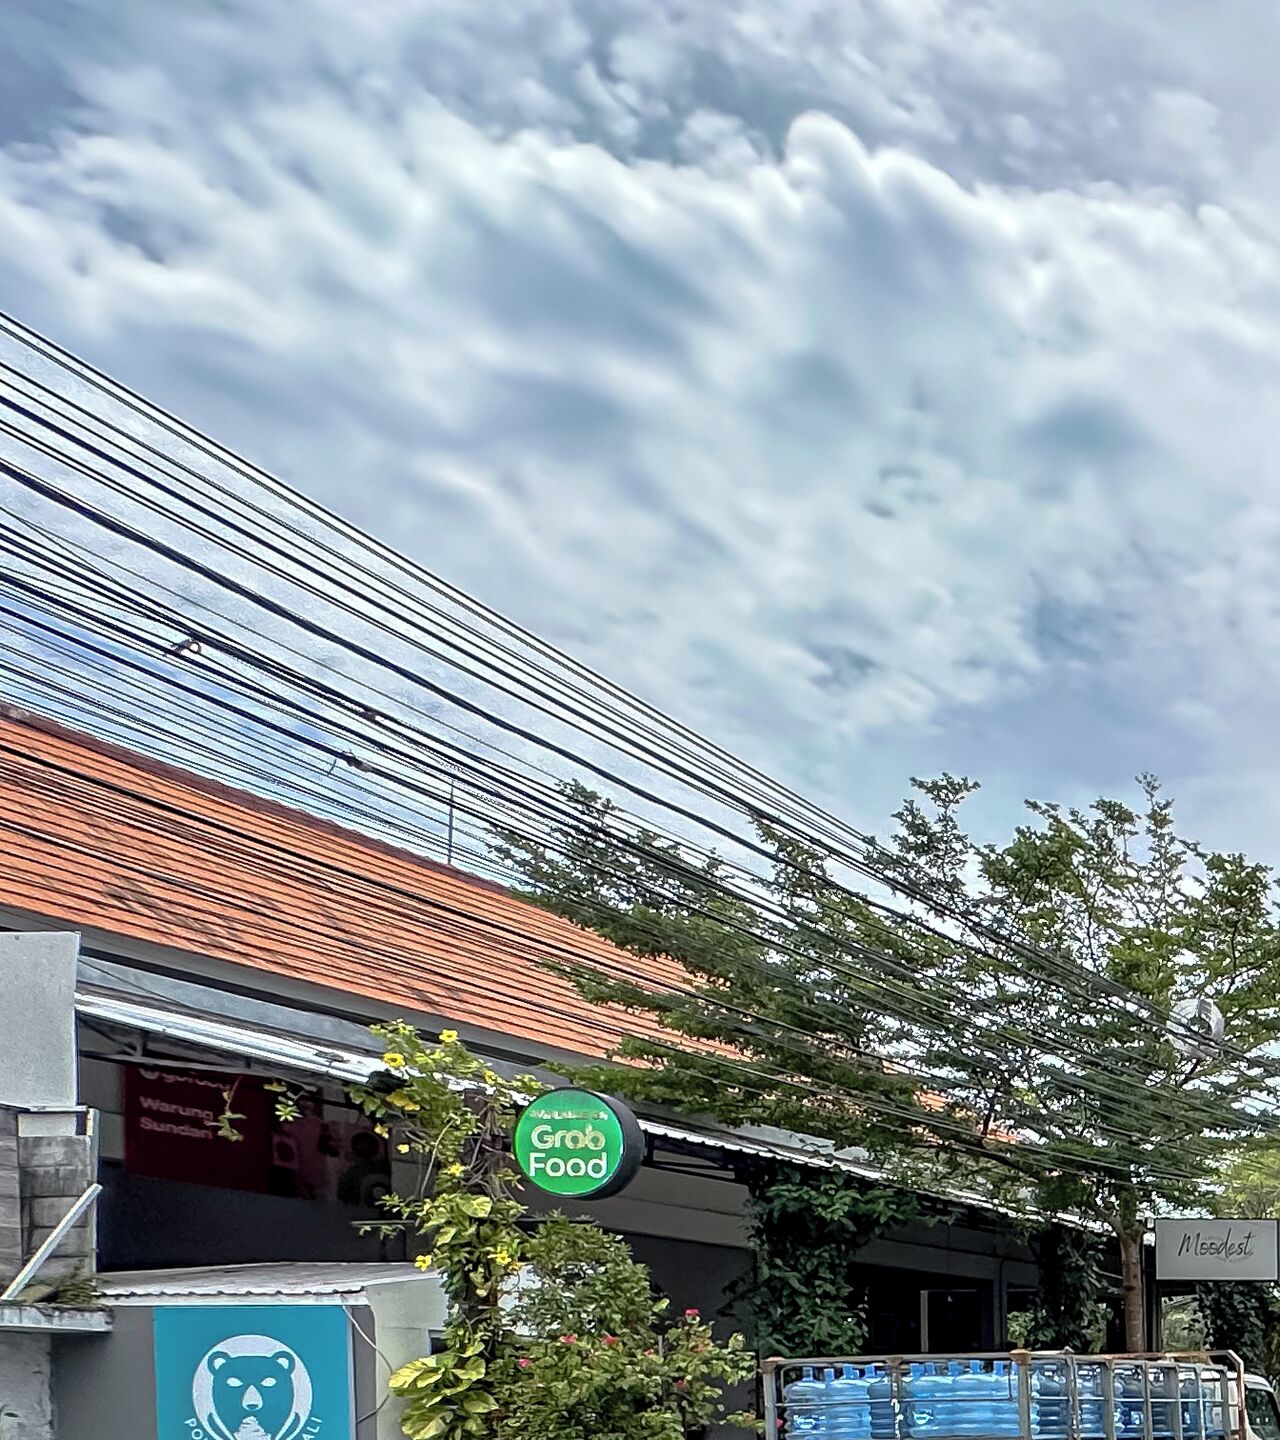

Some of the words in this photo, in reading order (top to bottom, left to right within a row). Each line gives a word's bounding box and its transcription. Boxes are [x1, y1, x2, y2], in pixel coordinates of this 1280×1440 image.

[139, 1096, 214, 1120] Warung
[530, 1123, 606, 1150] Grab
[529, 1152, 607, 1178] Food
